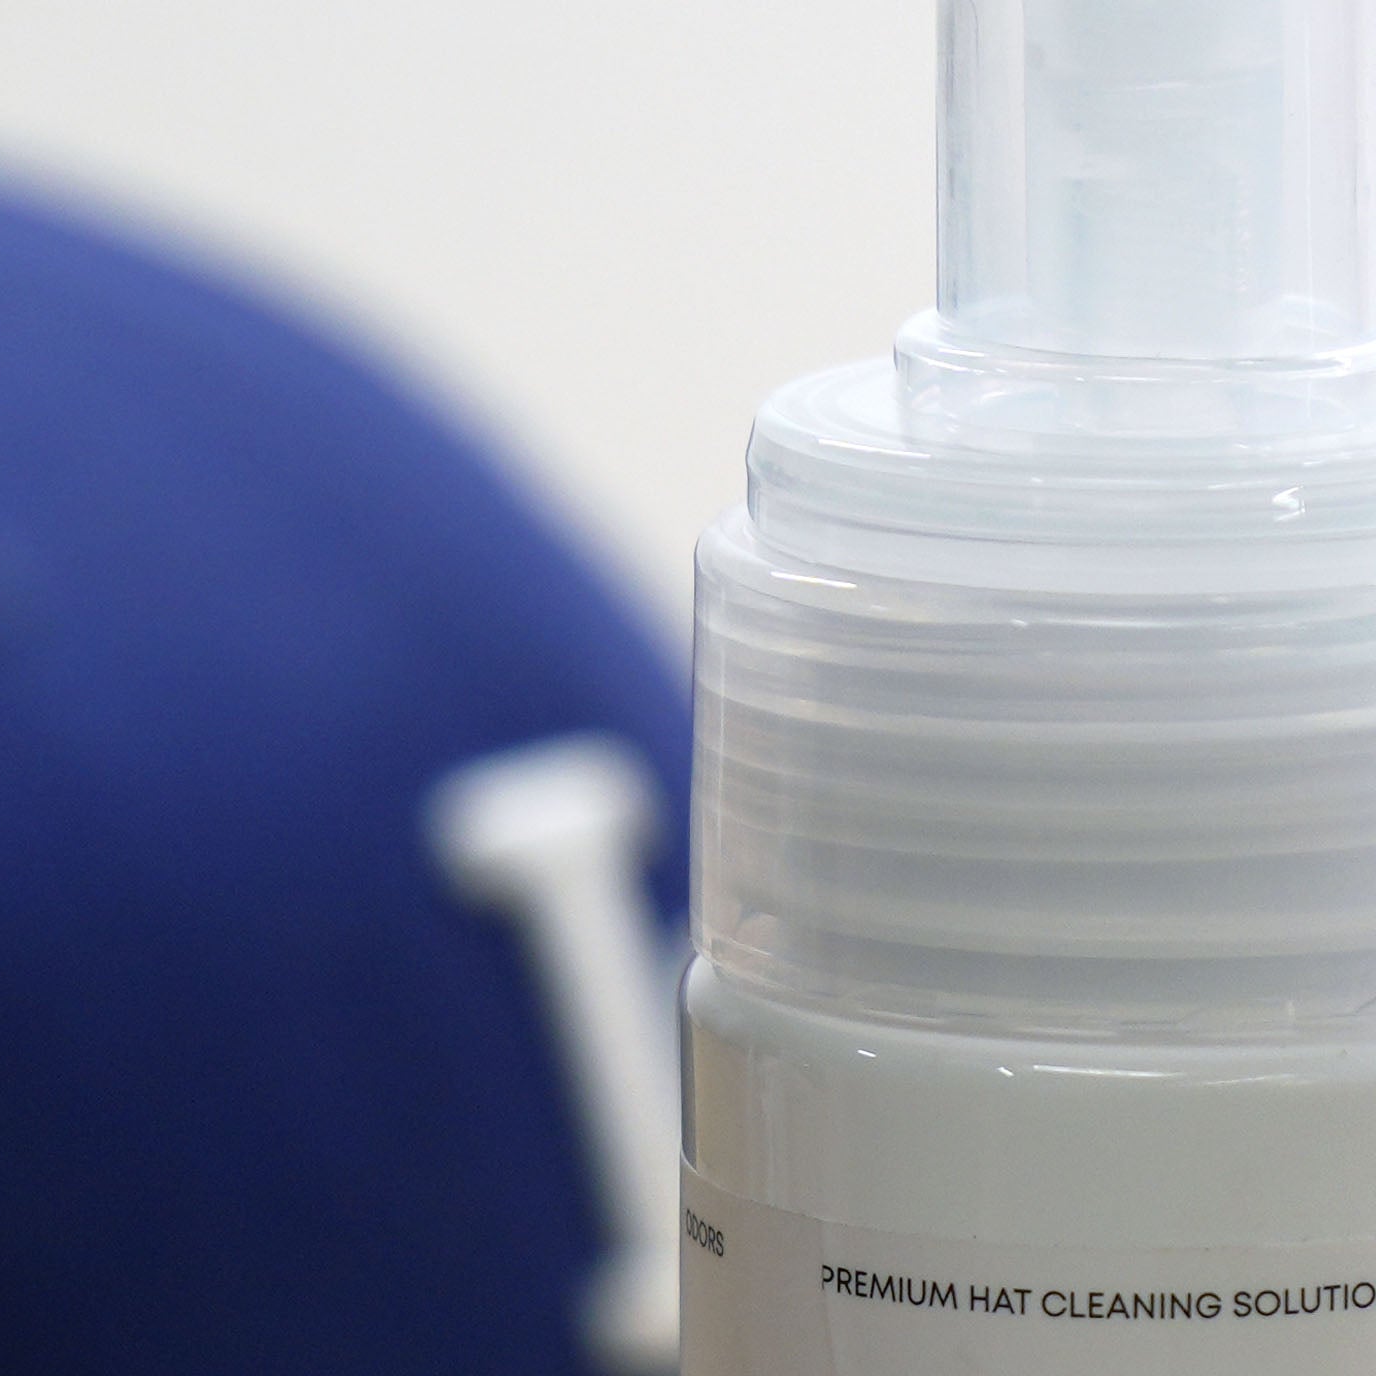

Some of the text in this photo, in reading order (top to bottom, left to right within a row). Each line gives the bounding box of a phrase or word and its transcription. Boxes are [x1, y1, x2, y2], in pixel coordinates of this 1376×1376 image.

[686, 1208, 724, 1257] ODORS
[822, 1264, 958, 1311] PREMIUM
[969, 1284, 1032, 1316] HAT
[1041, 1290, 1222, 1319] CLEANING
